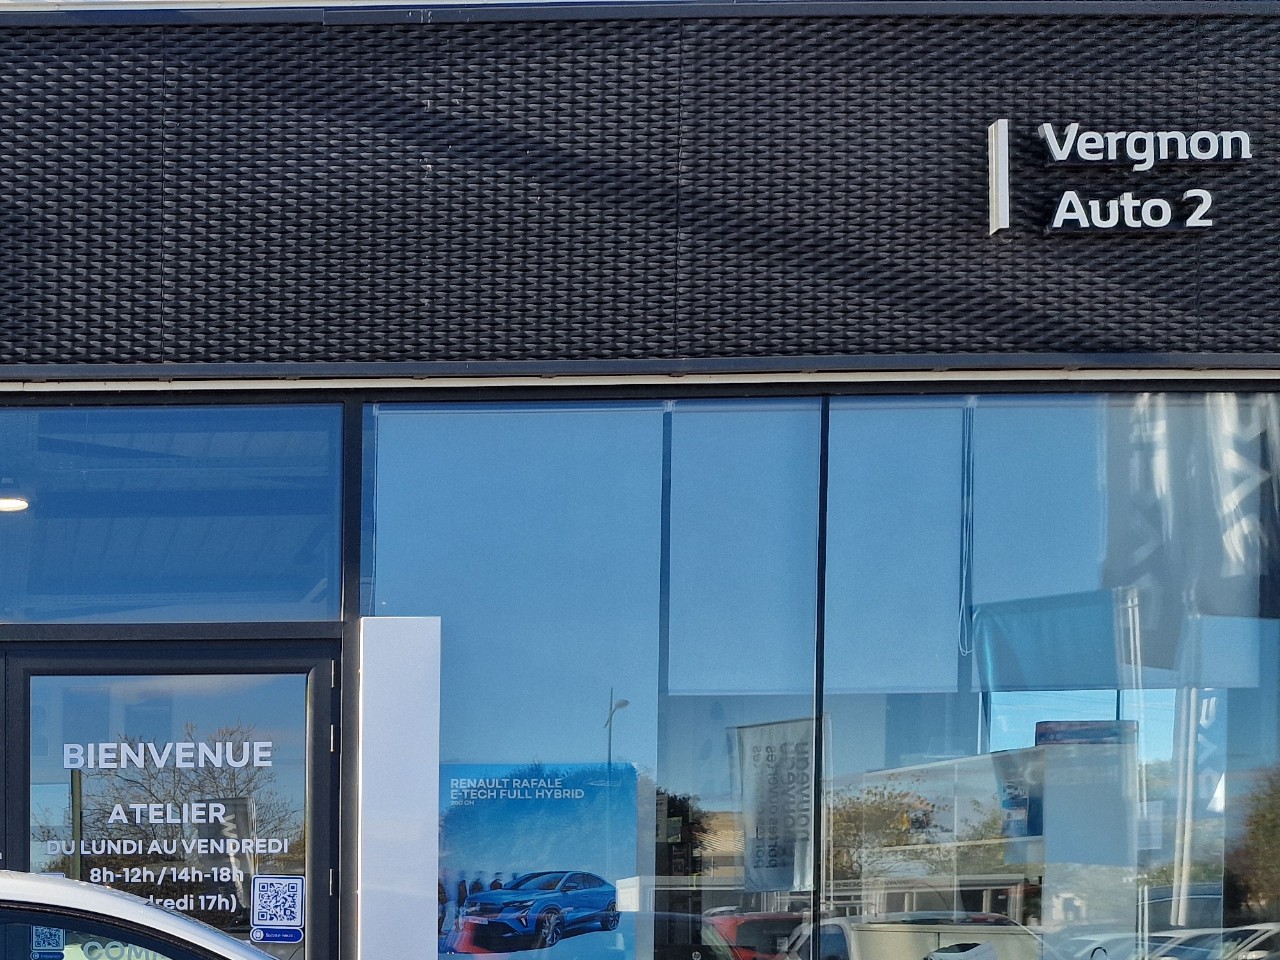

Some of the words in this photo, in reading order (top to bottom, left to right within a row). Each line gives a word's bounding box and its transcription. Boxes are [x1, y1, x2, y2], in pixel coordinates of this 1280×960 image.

[1038, 122, 1253, 172] Vergnon
[1051, 190, 1172, 228] Auto
[1182, 188, 1213, 228] 2
[63, 741, 273, 769] BIENVENUE
[450, 778, 510, 789] RENAULT
[512, 778, 563, 788] RAFALE
[450, 789, 497, 800] E-TECH
[500, 789, 532, 799] FULL
[535, 788, 585, 799] HYBRID
[107, 803, 226, 824] ATELIER
[47, 840, 75, 856] DU
[80, 839, 143, 855] LUNDI
[148, 839, 176, 855] AU
[181, 838, 288, 854] VENDREDI
[89, 866, 155, 883] 8h-12h
[171, 866, 244, 883] 14h-18h
[198, 893, 237, 913] 17h)
